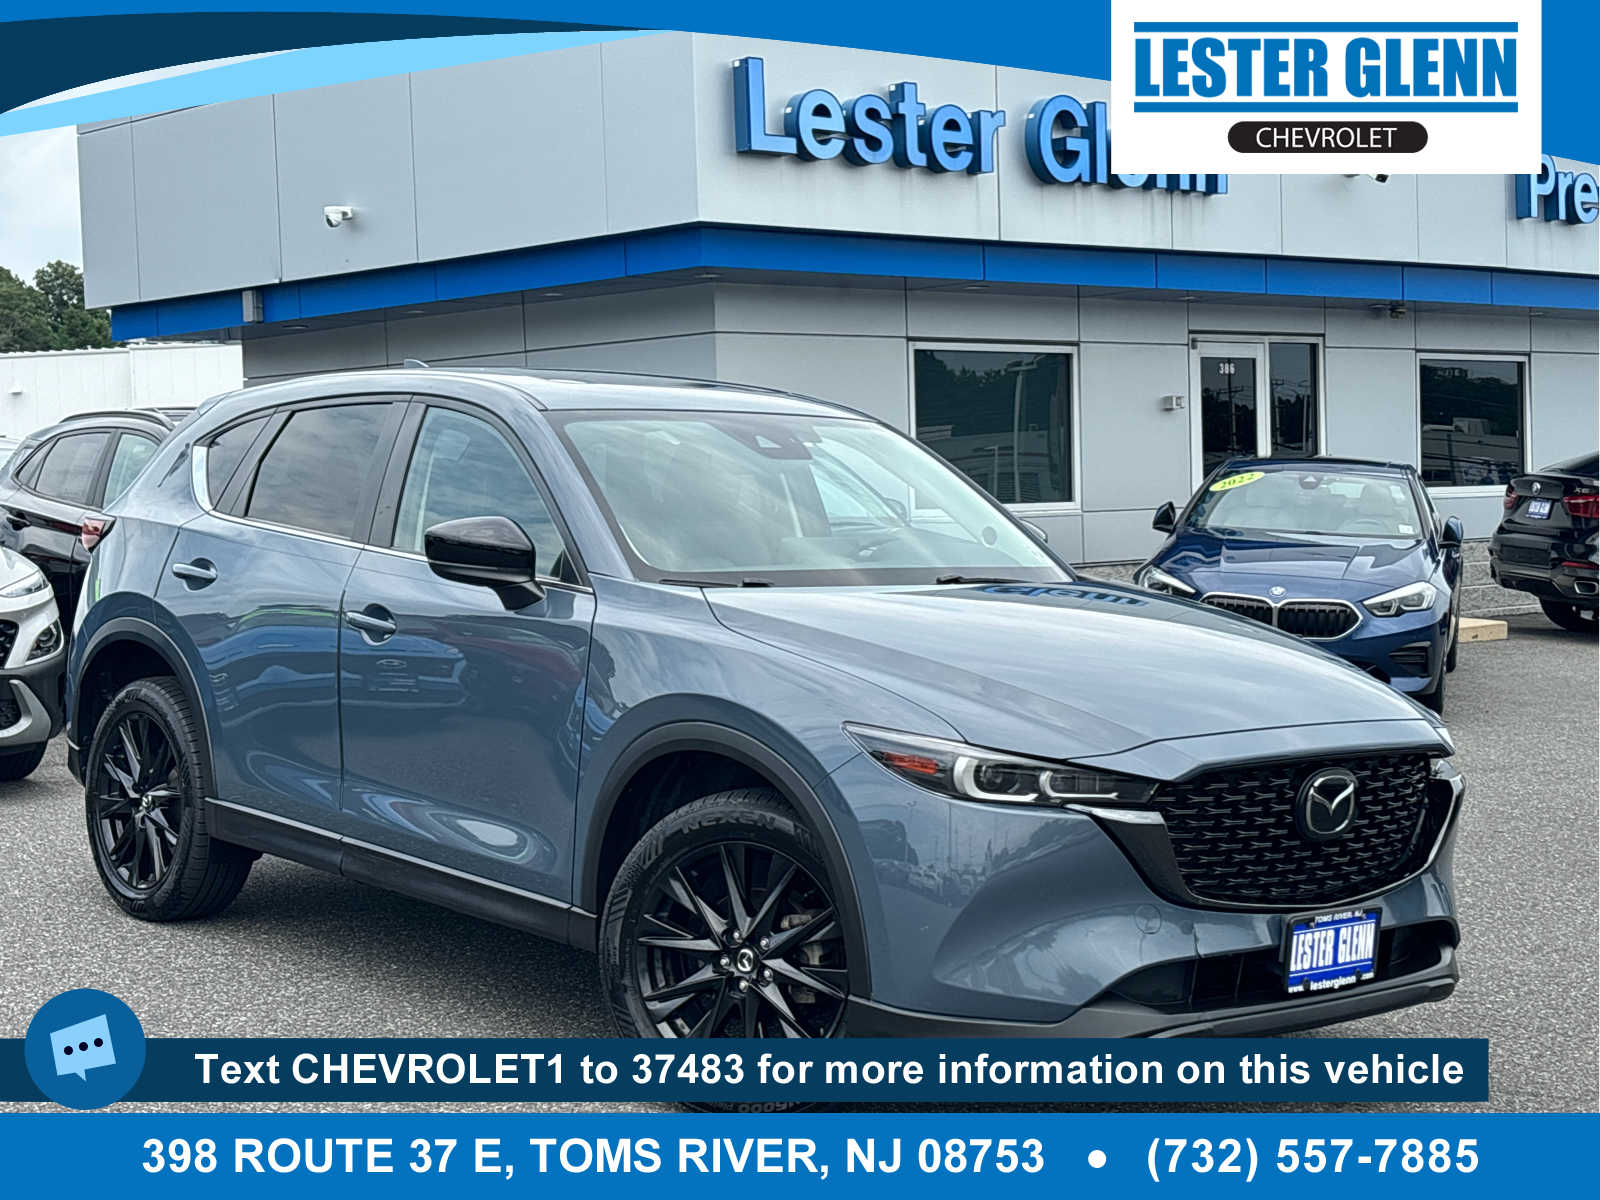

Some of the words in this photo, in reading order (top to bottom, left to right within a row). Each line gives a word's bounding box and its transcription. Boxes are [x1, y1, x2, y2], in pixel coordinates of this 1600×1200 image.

[733, 56, 1005, 174] Lester
[1220, 473, 1255, 489] 2022
[1290, 929, 1335, 971] LESTER
[1338, 923, 1375, 964] GLENN
